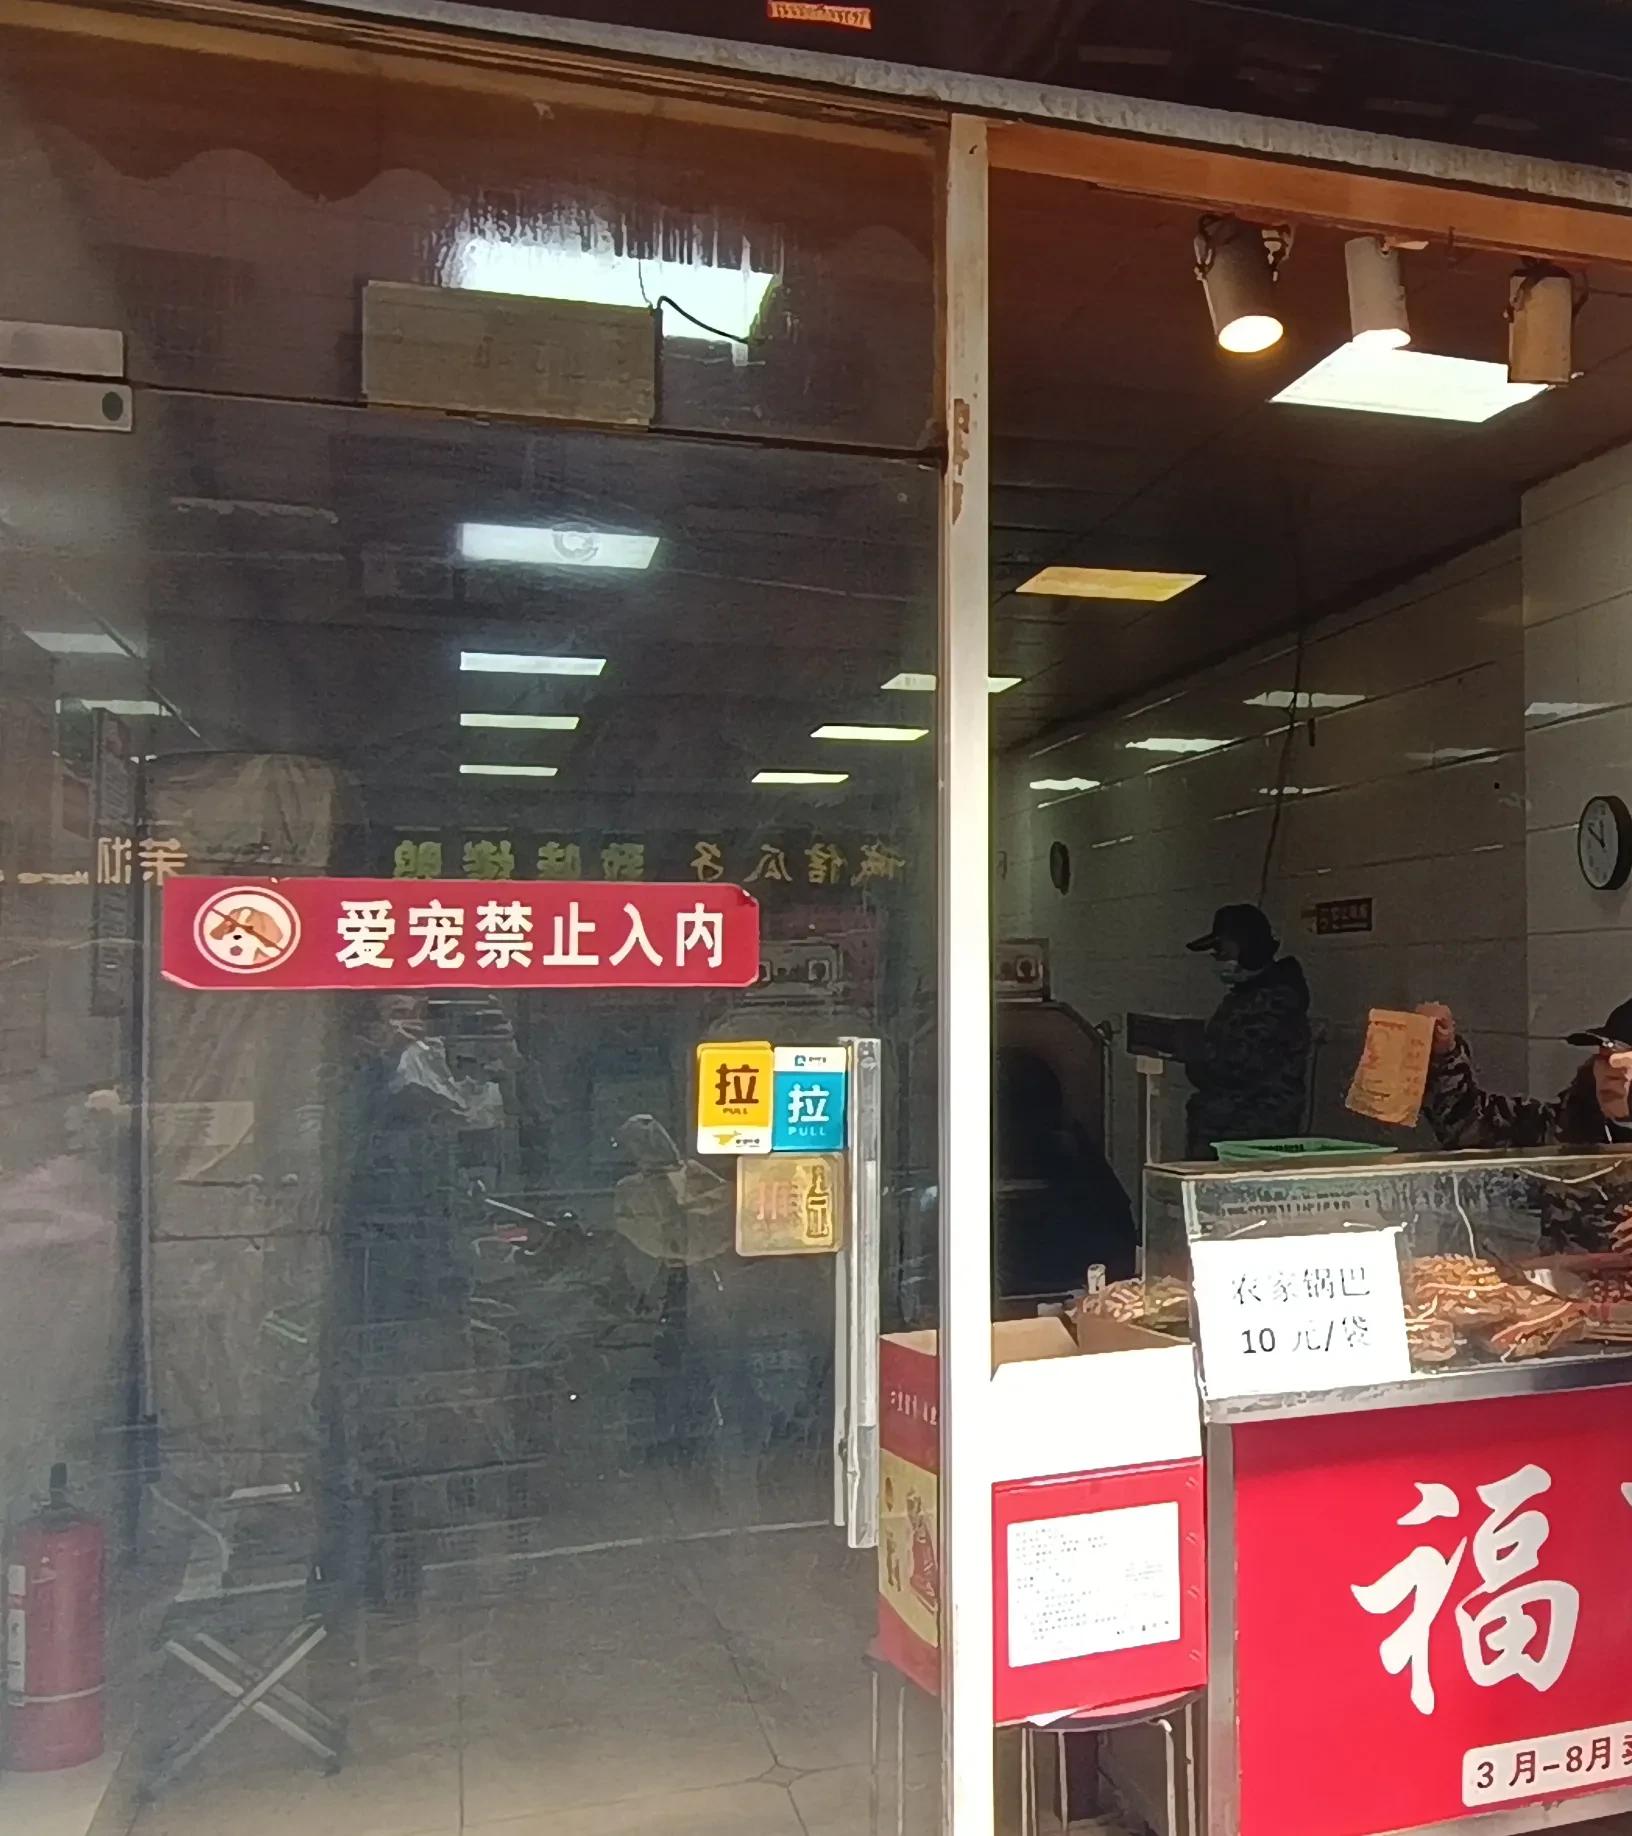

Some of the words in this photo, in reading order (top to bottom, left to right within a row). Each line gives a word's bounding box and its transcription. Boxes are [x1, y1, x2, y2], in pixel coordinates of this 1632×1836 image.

[336, 898, 724, 969] 爱宠禁止入内
[715, 1063, 759, 1105] 拉
[788, 1084, 830, 1123] 拉
[723, 1107, 748, 1115] PULL
[788, 1127, 827, 1137] PULL
[1232, 1266, 1371, 1305] 农家锅巴
